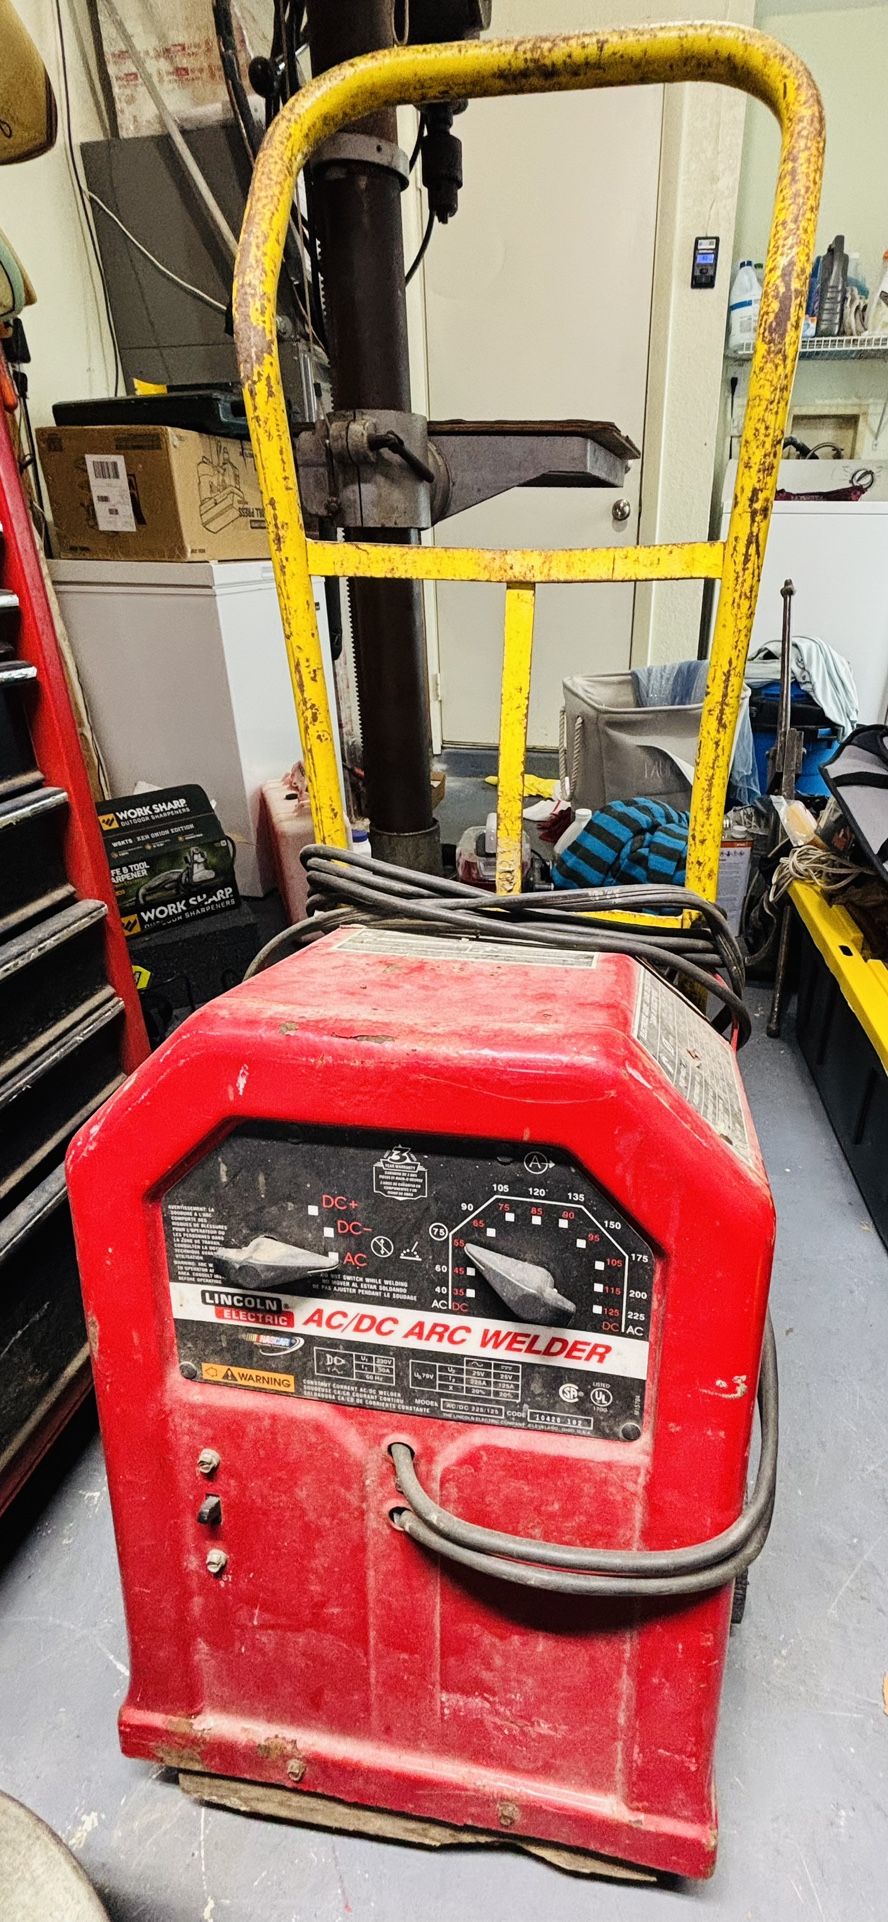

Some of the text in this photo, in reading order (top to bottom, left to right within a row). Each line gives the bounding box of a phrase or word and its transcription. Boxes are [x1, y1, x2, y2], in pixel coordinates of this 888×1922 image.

[116, 798, 187, 820] WORK SHARP
[120, 807, 191, 827] OUTDOOR SHARPENERS
[170, 824, 195, 834] EDITION
[128, 861, 150, 872] TOOL
[140, 900, 187, 923] WORK
[492, 1184, 510, 1194] 105
[528, 1187, 546, 1197] 120
[567, 1192, 585, 1202] 135
[461, 1203, 474, 1211] 90
[498, 1203, 511, 1212] 75
[530, 1206, 543, 1216] 85
[472, 1219, 485, 1228] 65
[604, 1220, 622, 1230] 150
[433, 1227, 446, 1236] 75
[587, 1234, 600, 1242] 95
[453, 1239, 465, 1248] 55
[343, 1252, 368, 1267] AC
[606, 1258, 623, 1267] 105
[631, 1253, 649, 1263] 175
[435, 1264, 447, 1273] 60
[453, 1267, 465, 1275] 45
[343, 1274, 364, 1282] SWITCH
[365, 1277, 382, 1285] WHILE
[384, 1279, 408, 1287] WELDING
[333, 1286, 357, 1294] AJUSTER
[435, 1286, 447, 1294] 40
[453, 1288, 465, 1297] 35
[604, 1286, 621, 1296] 115
[629, 1290, 648, 1300] 200
[204, 1292, 277, 1311] LINCOLN
[431, 1299, 448, 1310] AC
[452, 1303, 470, 1313] DC
[603, 1307, 620, 1317] 125
[223, 1308, 288, 1326] ELECTRIC
[627, 1311, 646, 1321] 225
[602, 1321, 620, 1332] DC
[626, 1326, 644, 1337] AC
[302, 1308, 613, 1364] AC/DC ARC WELDER
[237, 1371, 291, 1388] WARNING
[332, 1381, 358, 1392] CURRENT
[378, 1390, 401, 1398] WELDER
[592, 1381, 611, 1389] LISTED
[595, 1390, 608, 1404] UL
[414, 1398, 439, 1408] MODEL
[446, 1402, 469, 1411] AC/DC
[471, 1406, 499, 1415] 225/125
[506, 1410, 527, 1418] CODE
[475, 1416, 500, 1424] ELECTRIC
